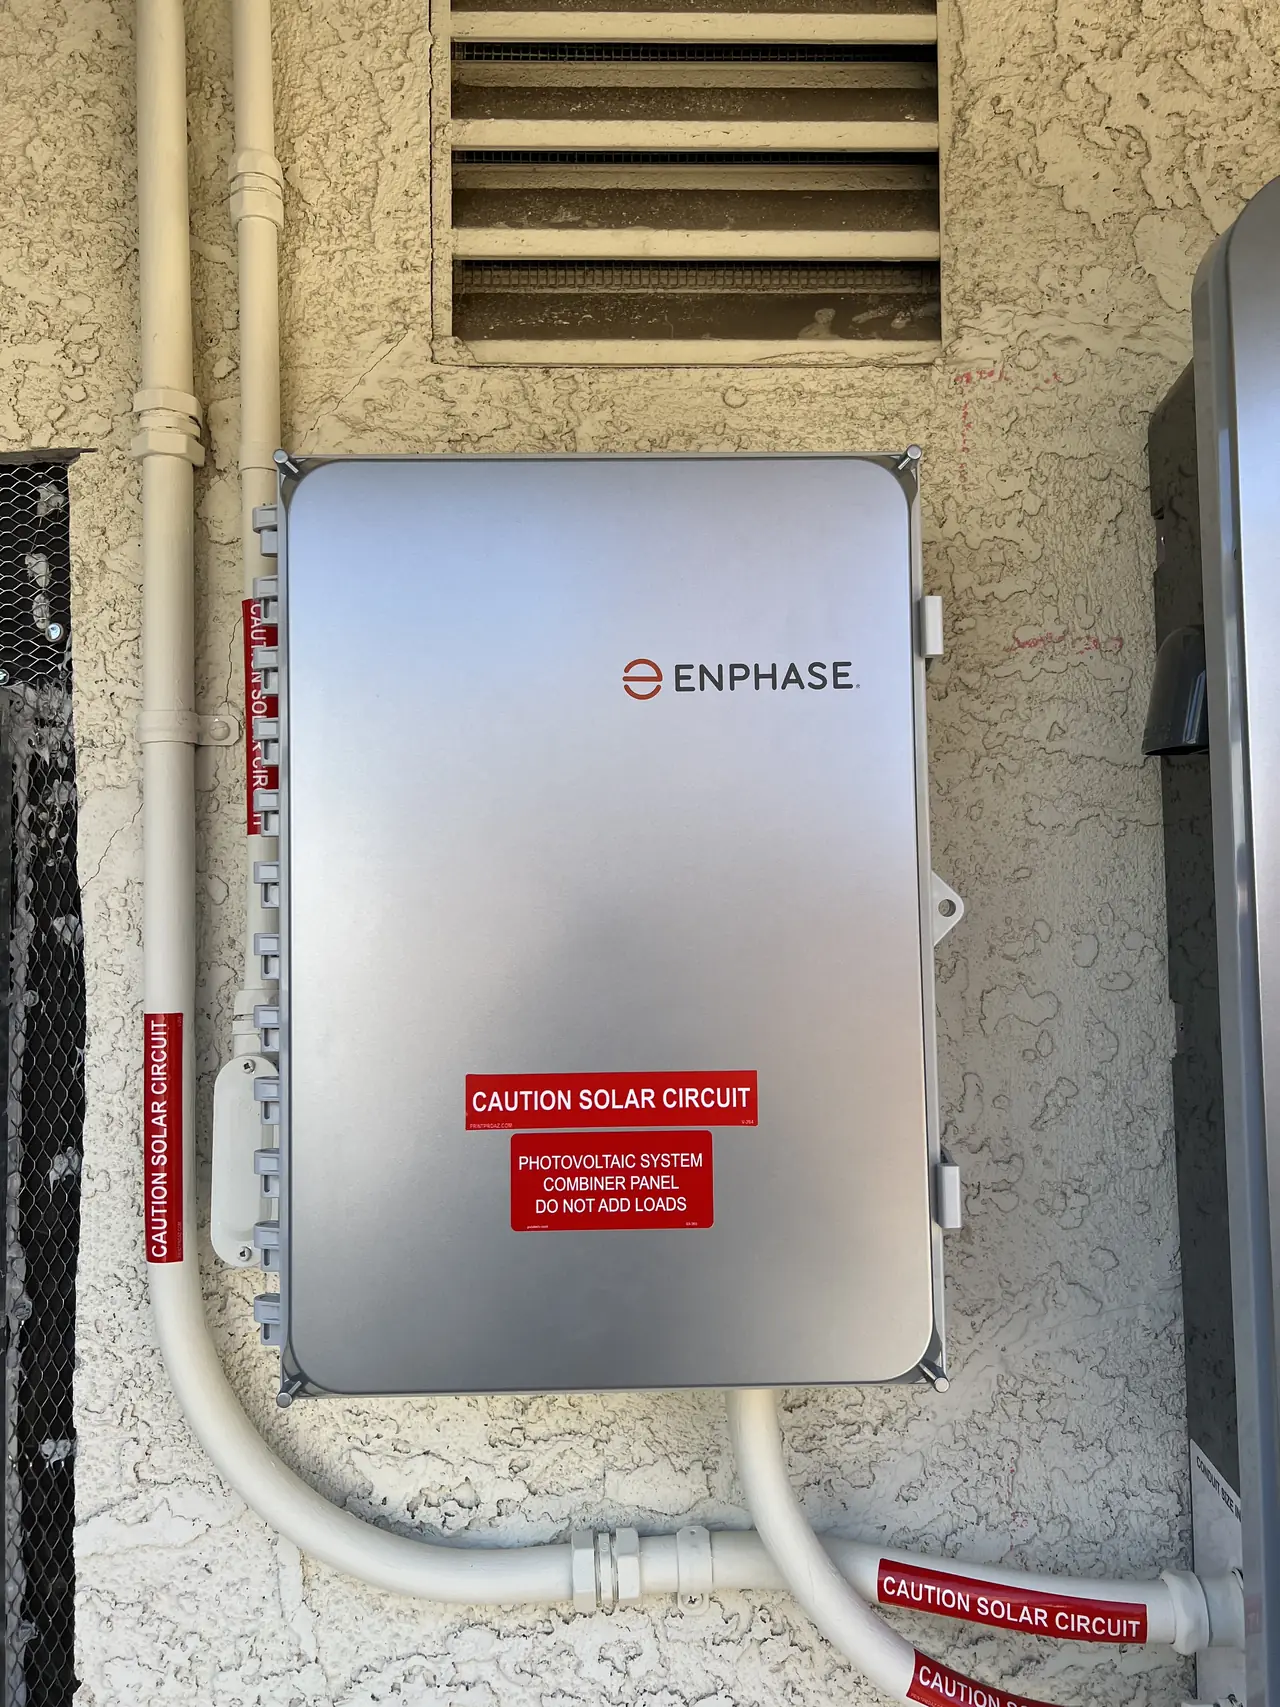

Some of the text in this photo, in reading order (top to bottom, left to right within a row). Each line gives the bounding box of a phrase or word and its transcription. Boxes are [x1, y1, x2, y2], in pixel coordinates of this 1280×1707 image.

[250, 603, 267, 683] CAUTN
[472, 1087, 751, 1112] CAUTION SOLAR CIRCUIT
[151, 1020, 168, 1258] CAUTION SOLAR CIRCUIT
[518, 1153, 703, 1171] PHOTOVOLTAIC SYSTEM
[543, 1175, 680, 1192] COMBINER PANEL
[535, 1197, 687, 1214] DO NOT ADD LOADS
[883, 1576, 1141, 1638] CAUTION SOLAR CIRCUIT
[919, 1665, 1000, 1707] CAUTION
